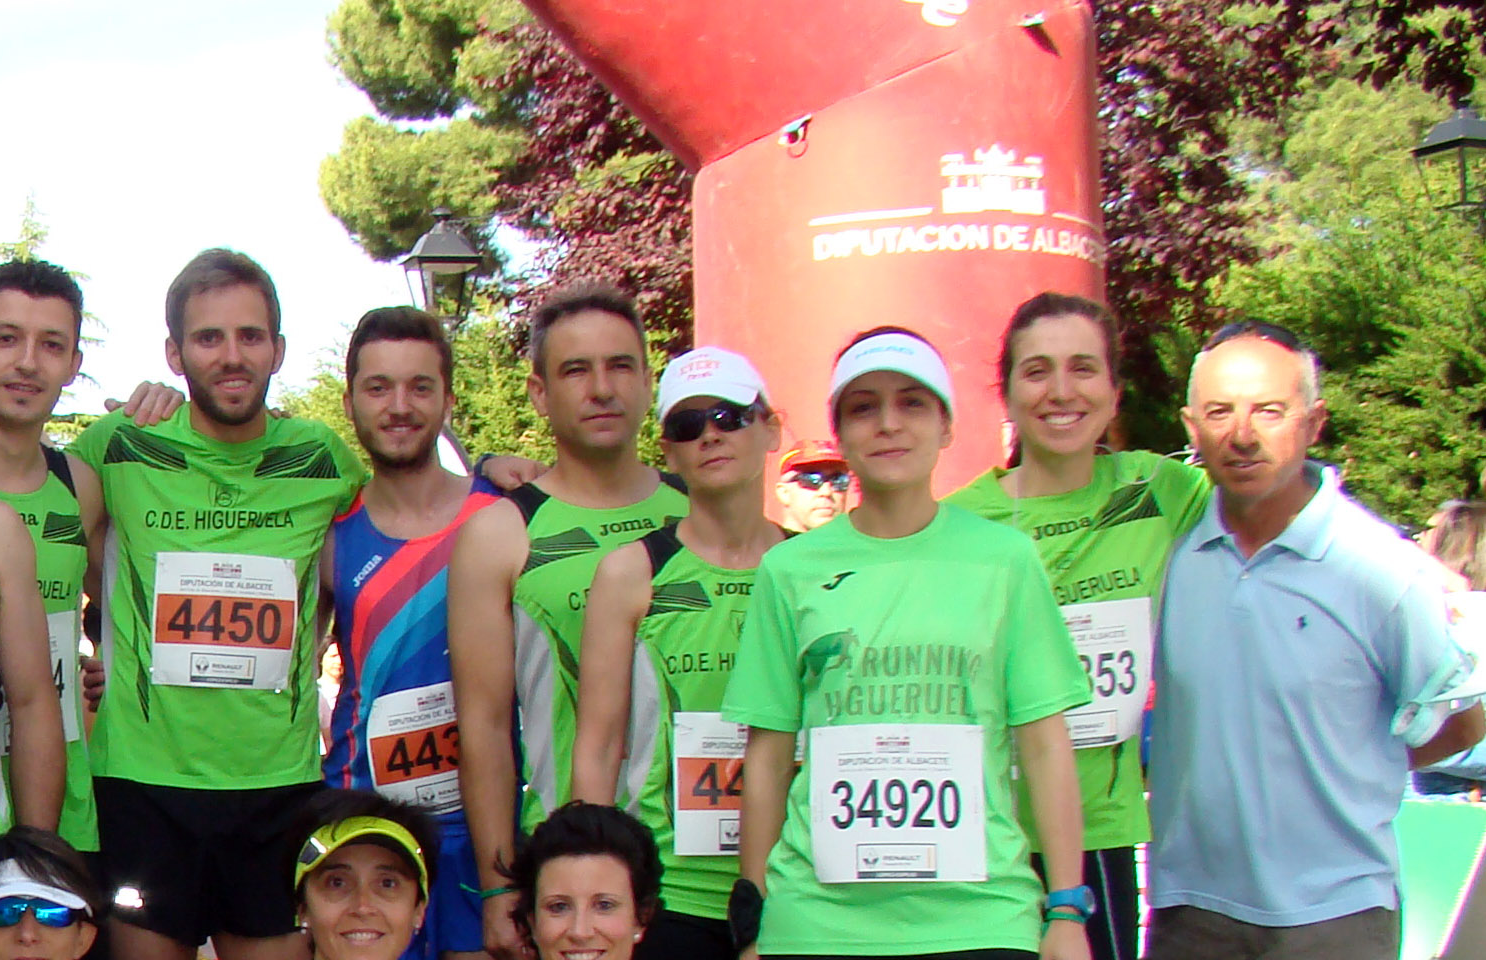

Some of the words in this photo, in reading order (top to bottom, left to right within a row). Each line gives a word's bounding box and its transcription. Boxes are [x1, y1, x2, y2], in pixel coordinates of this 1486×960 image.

[993, 225, 1029, 251] DE
[145, 510, 189, 530] C.D.E.
[195, 510, 294, 530] HIGUERUELA
[599, 516, 656, 536] Joma
[1032, 515, 1093, 541] Joma
[351, 554, 383, 588] Joma
[1052, 567, 1143, 606] GUERUELA
[167, 598, 282, 645] 4450
[666, 653, 714, 675] C.D.E.
[386, 725, 459, 777] 443
[830, 779, 962, 830] 34920
